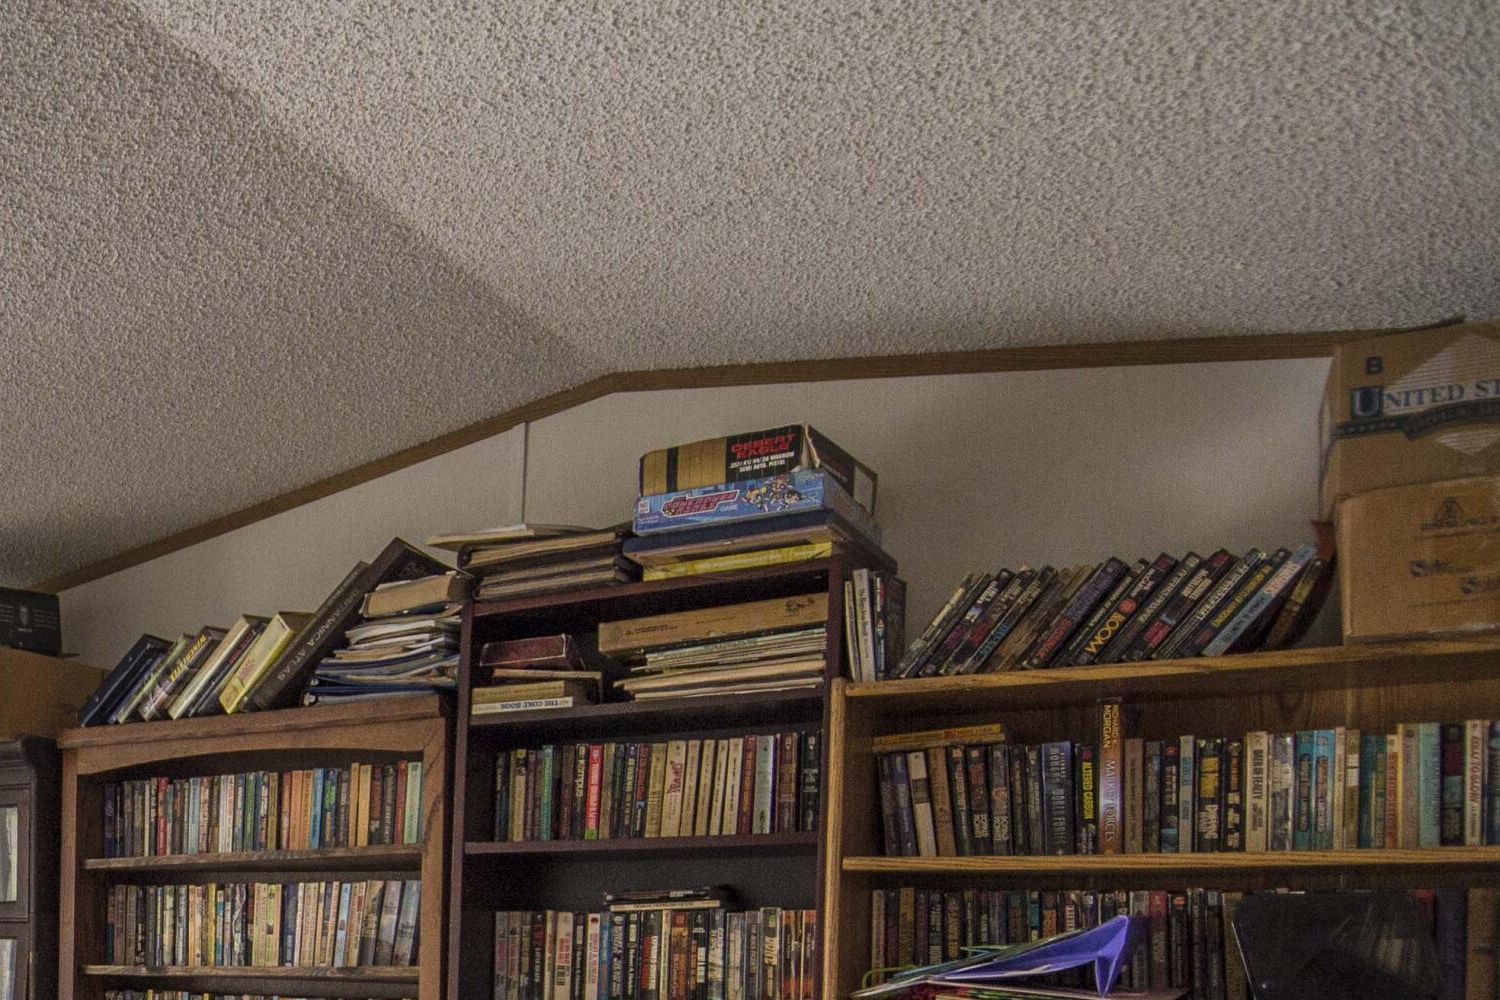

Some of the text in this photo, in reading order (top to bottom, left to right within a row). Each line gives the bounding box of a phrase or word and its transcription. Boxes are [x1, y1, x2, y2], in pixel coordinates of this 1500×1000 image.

[1365, 357, 1384, 375] B
[1352, 384, 1463, 419] UNITED
[1102, 704, 1112, 748] MORGAN
[1082, 762, 1093, 790] ALTERED
[764, 936, 778, 966] DUNE
